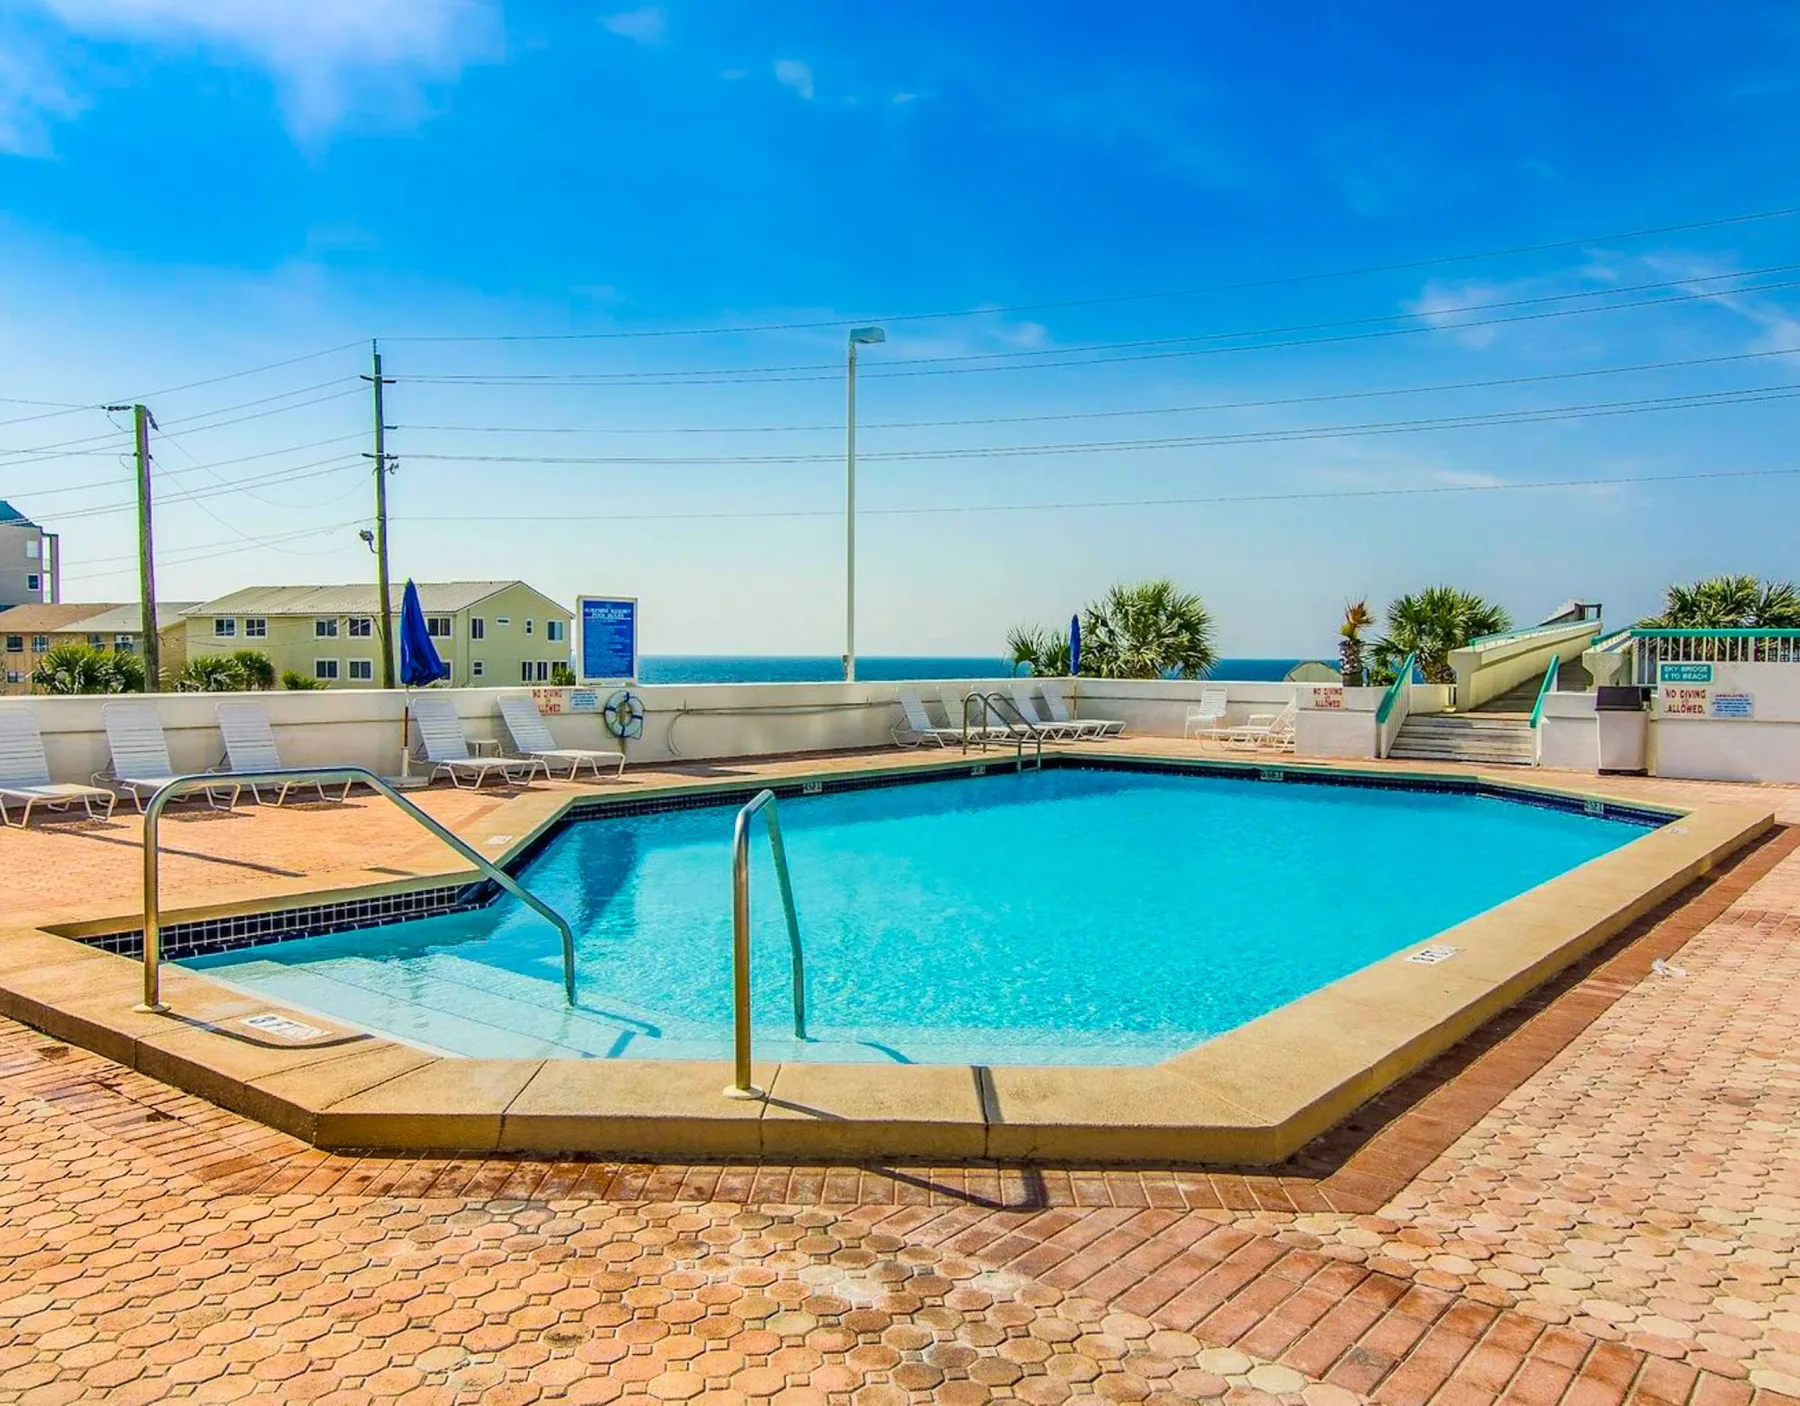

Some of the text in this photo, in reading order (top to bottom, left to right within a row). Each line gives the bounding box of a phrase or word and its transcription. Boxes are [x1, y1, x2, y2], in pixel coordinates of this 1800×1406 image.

[1665, 688, 1706, 699] NO DIVING
[537, 704, 561, 713] LLOWED
